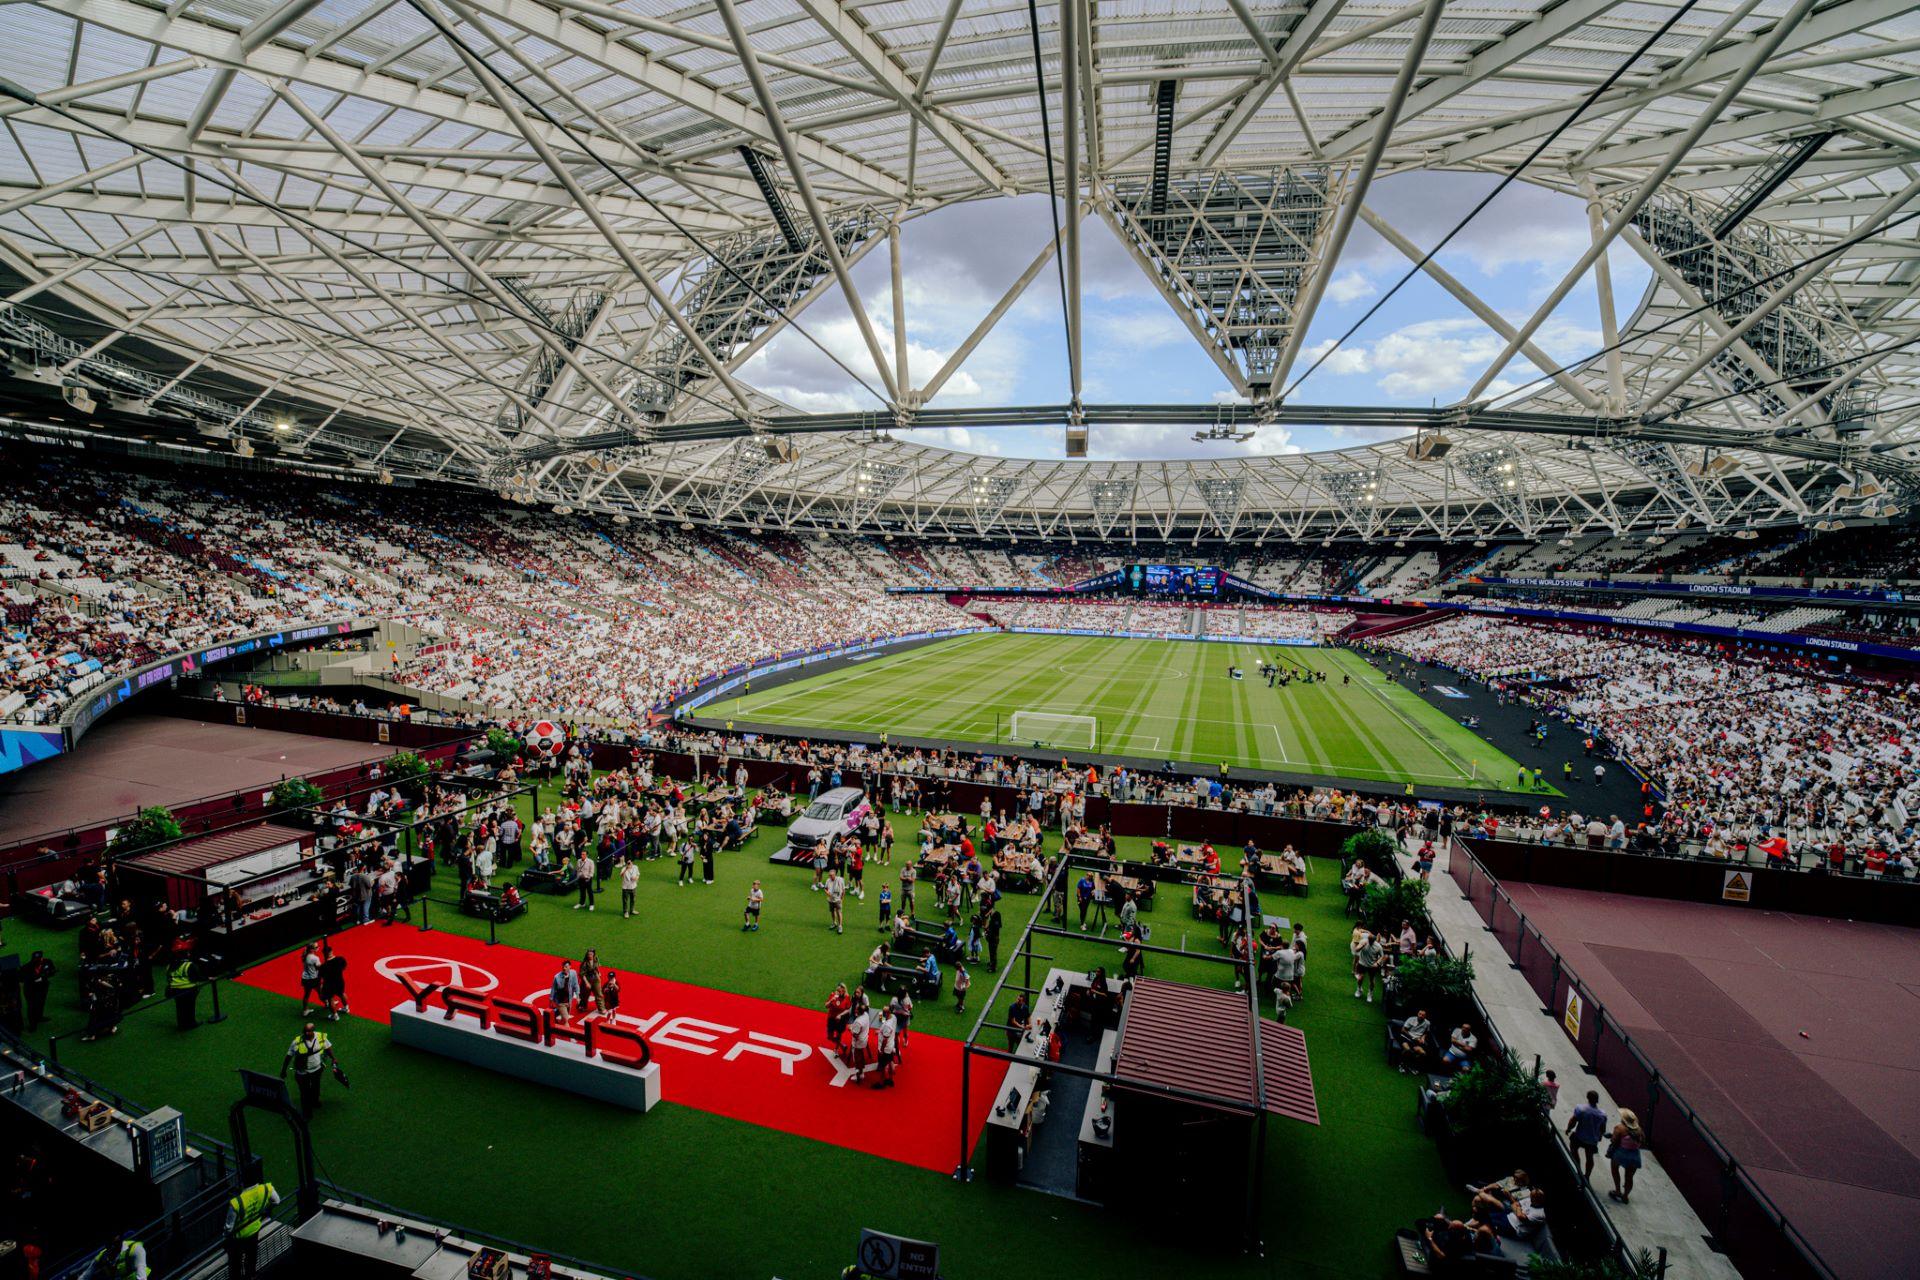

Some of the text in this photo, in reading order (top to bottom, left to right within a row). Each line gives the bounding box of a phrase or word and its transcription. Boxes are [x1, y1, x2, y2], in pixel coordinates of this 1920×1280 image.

[1689, 584, 1751, 595] LONDON STADIUM
[1805, 637, 1858, 651] LONDON STADIUM
[910, 1252, 925, 1262] NO
[900, 1262, 933, 1275] ENTRY
